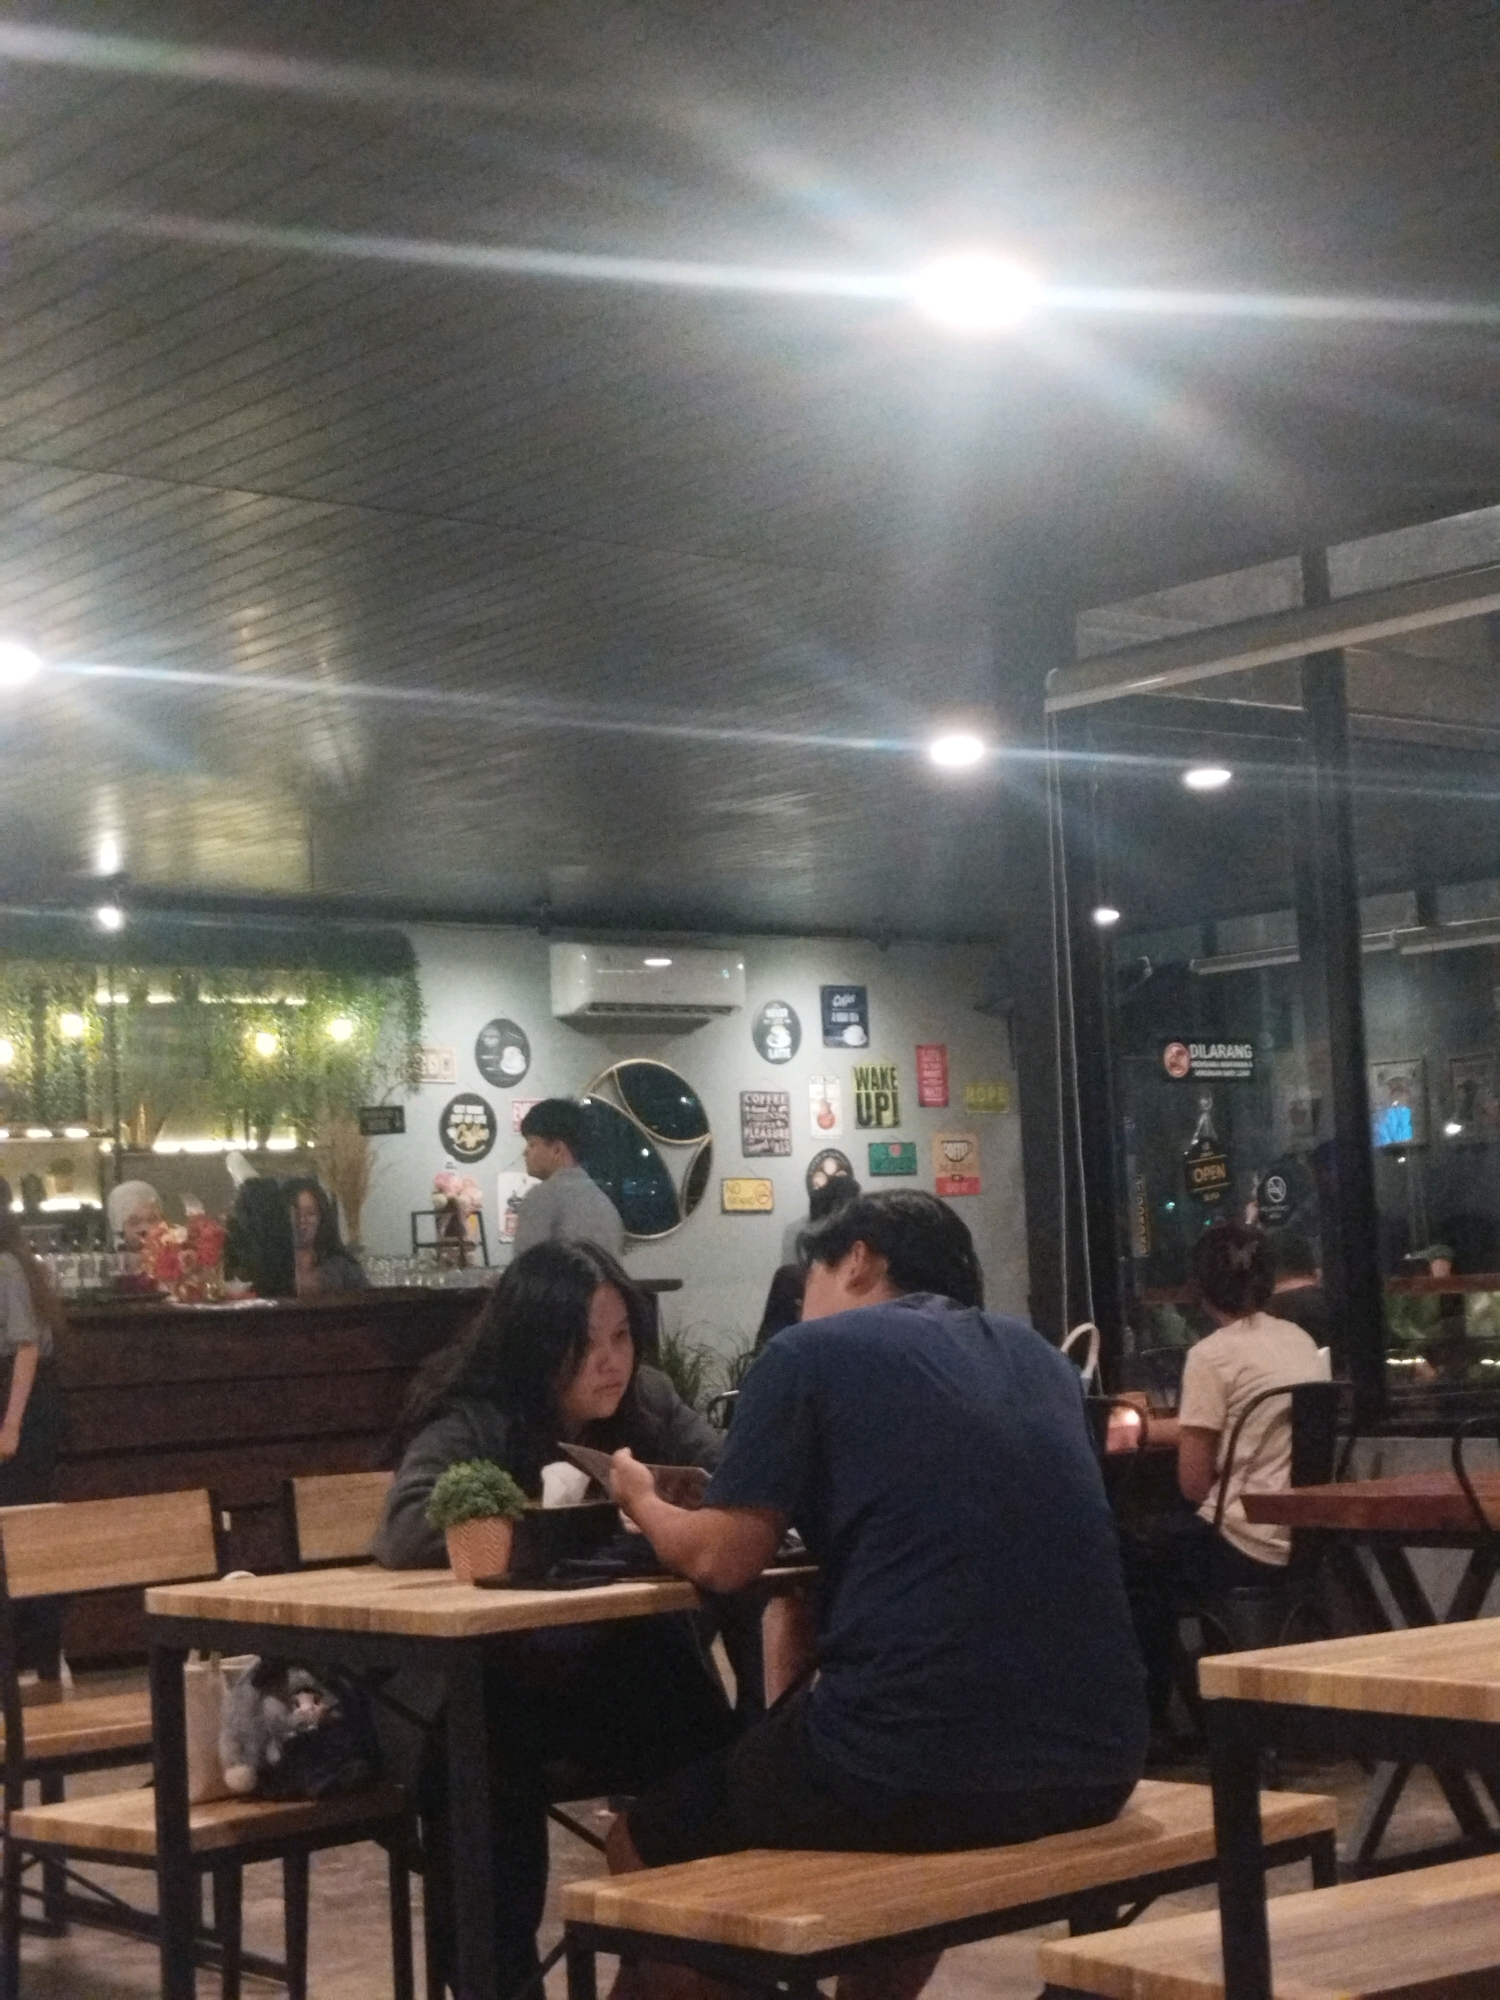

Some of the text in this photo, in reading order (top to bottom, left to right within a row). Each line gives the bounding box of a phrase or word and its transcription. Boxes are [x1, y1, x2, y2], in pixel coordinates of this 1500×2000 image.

[1189, 1044, 1253, 1059] DILARANG
[854, 1066, 898, 1091] WAKE
[745, 1094, 786, 1105] COFFEE
[856, 1092, 899, 1126] UP!
[1193, 1163, 1226, 1183] OPEN
